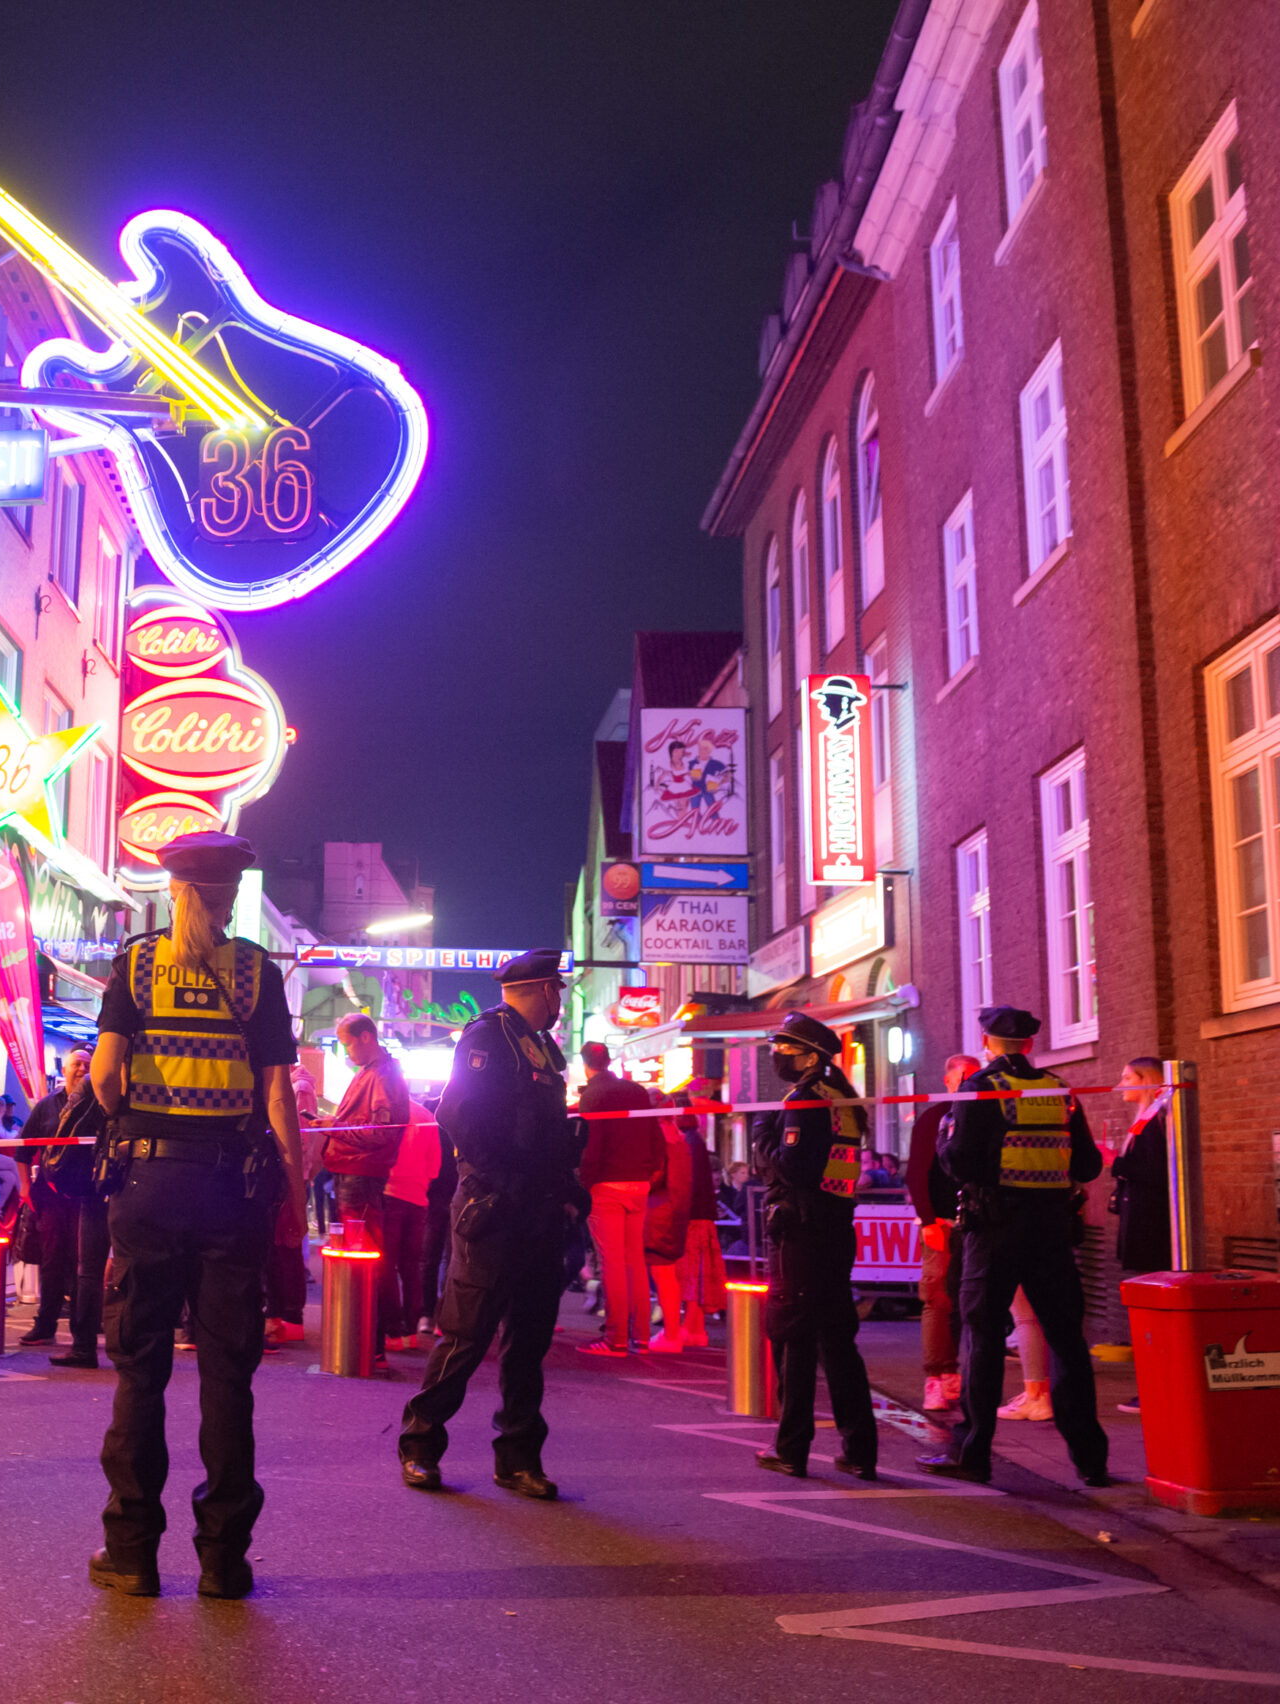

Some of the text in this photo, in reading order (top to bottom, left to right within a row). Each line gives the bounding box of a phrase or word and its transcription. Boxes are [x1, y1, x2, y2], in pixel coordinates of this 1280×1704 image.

[201, 425, 312, 538] 36
[138, 625, 220, 656] Colibri
[130, 705, 265, 754] Colibri
[827, 734, 856, 854] HIGHWAY
[647, 799, 739, 840] Alm
[678, 901, 719, 914] THAI
[656, 919, 736, 933] KARAOKE
[644, 938, 747, 950] COCKTAIL BAR
[386, 949, 568, 970] SPIELHAE
[154, 964, 234, 989] POLIZEI
[621, 994, 658, 1009] Coca-Cola
[1212, 1372, 1280, 1384] Müllkomm
